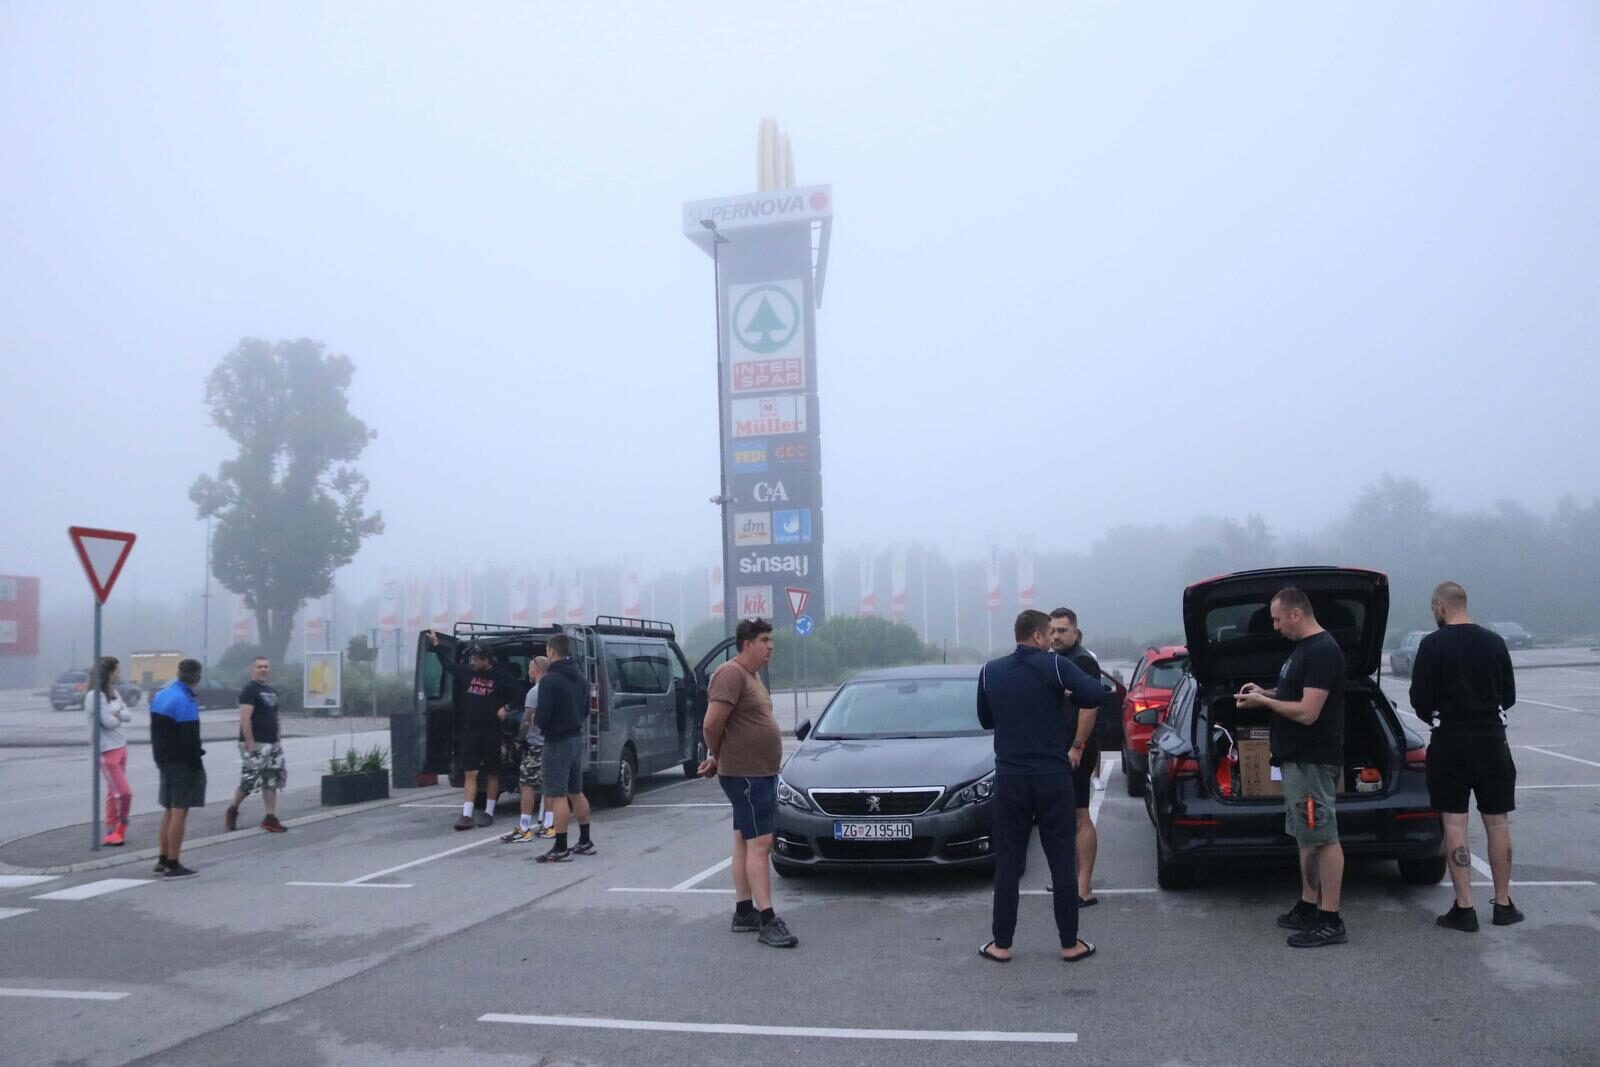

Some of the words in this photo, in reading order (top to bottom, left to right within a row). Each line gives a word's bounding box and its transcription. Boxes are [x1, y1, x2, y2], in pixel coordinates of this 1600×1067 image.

[687, 194, 805, 226] SUPERNOVA
[735, 360, 800, 376] INTER
[742, 371, 800, 388] SPAR
[735, 417, 803, 436] Müller
[775, 445, 808, 459] CCC
[753, 480, 790, 502] C&A
[743, 518, 764, 533] dm
[738, 551, 808, 577] sinsay
[466, 685, 494, 696] ARMY
[843, 824, 858, 837] ZG
